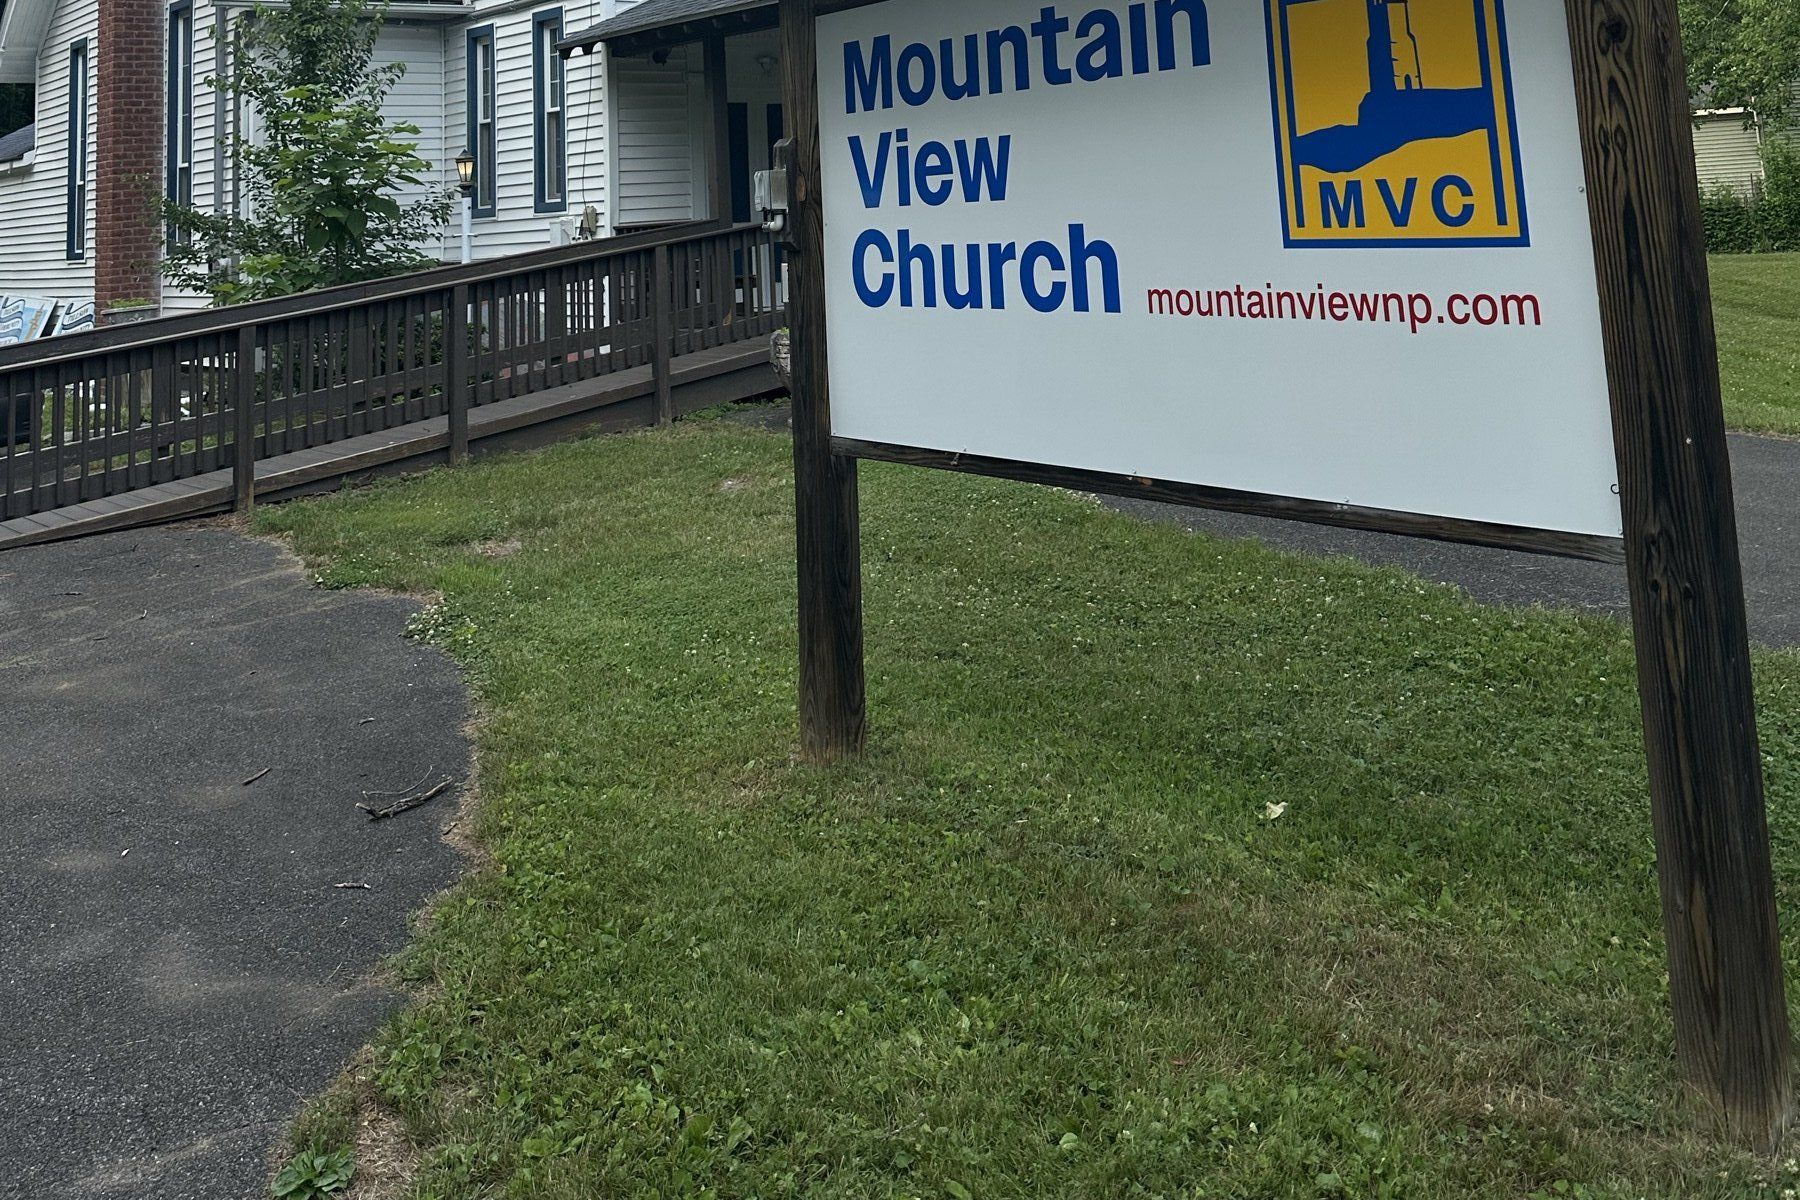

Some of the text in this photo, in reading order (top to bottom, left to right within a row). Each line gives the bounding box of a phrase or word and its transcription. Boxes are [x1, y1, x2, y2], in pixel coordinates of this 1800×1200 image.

[848, 128, 1012, 210] View
[1319, 175, 1475, 228] MVC
[851, 222, 1122, 315] Church
[1147, 284, 1542, 334] mountainviewnp.com
